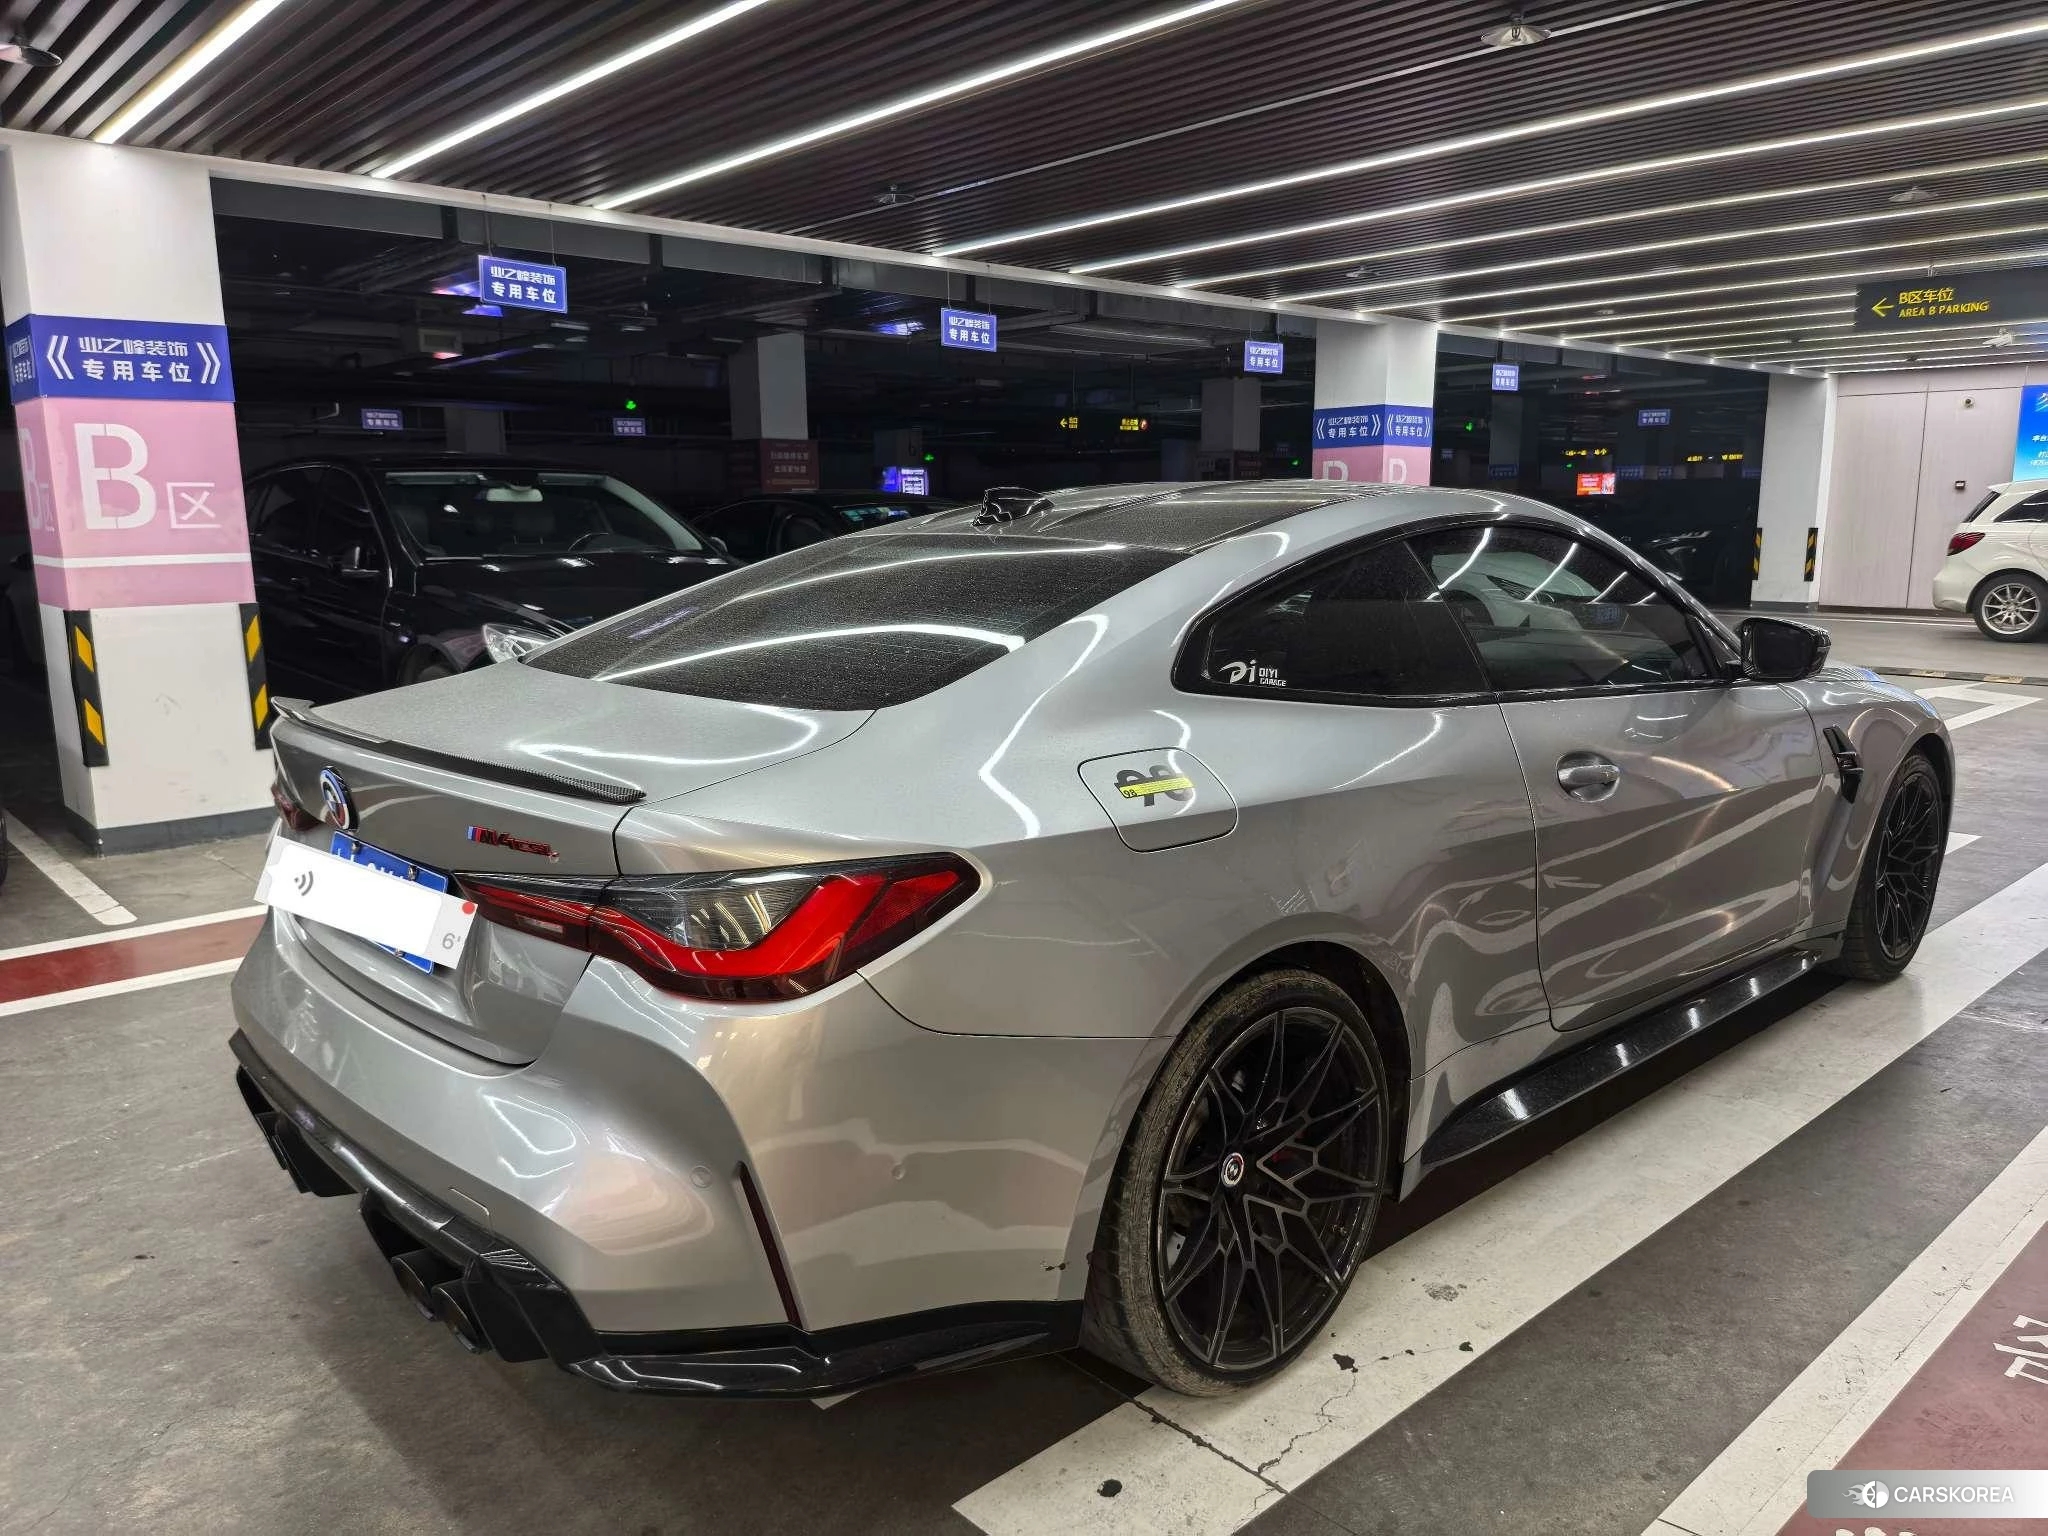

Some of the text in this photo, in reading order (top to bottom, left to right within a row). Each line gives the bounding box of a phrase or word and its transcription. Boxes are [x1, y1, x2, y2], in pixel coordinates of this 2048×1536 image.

[490, 265, 556, 286] 业之峰装饰
[491, 281, 556, 304] 专用车位
[1899, 287, 1953, 304] B区车位
[1899, 301, 1989, 318] AREA B PARKING
[949, 328, 990, 344] 专用车位
[78, 336, 189, 358] 业之峰装饰
[82, 358, 192, 384] 专用车位
[1327, 425, 1368, 439] 专用车位
